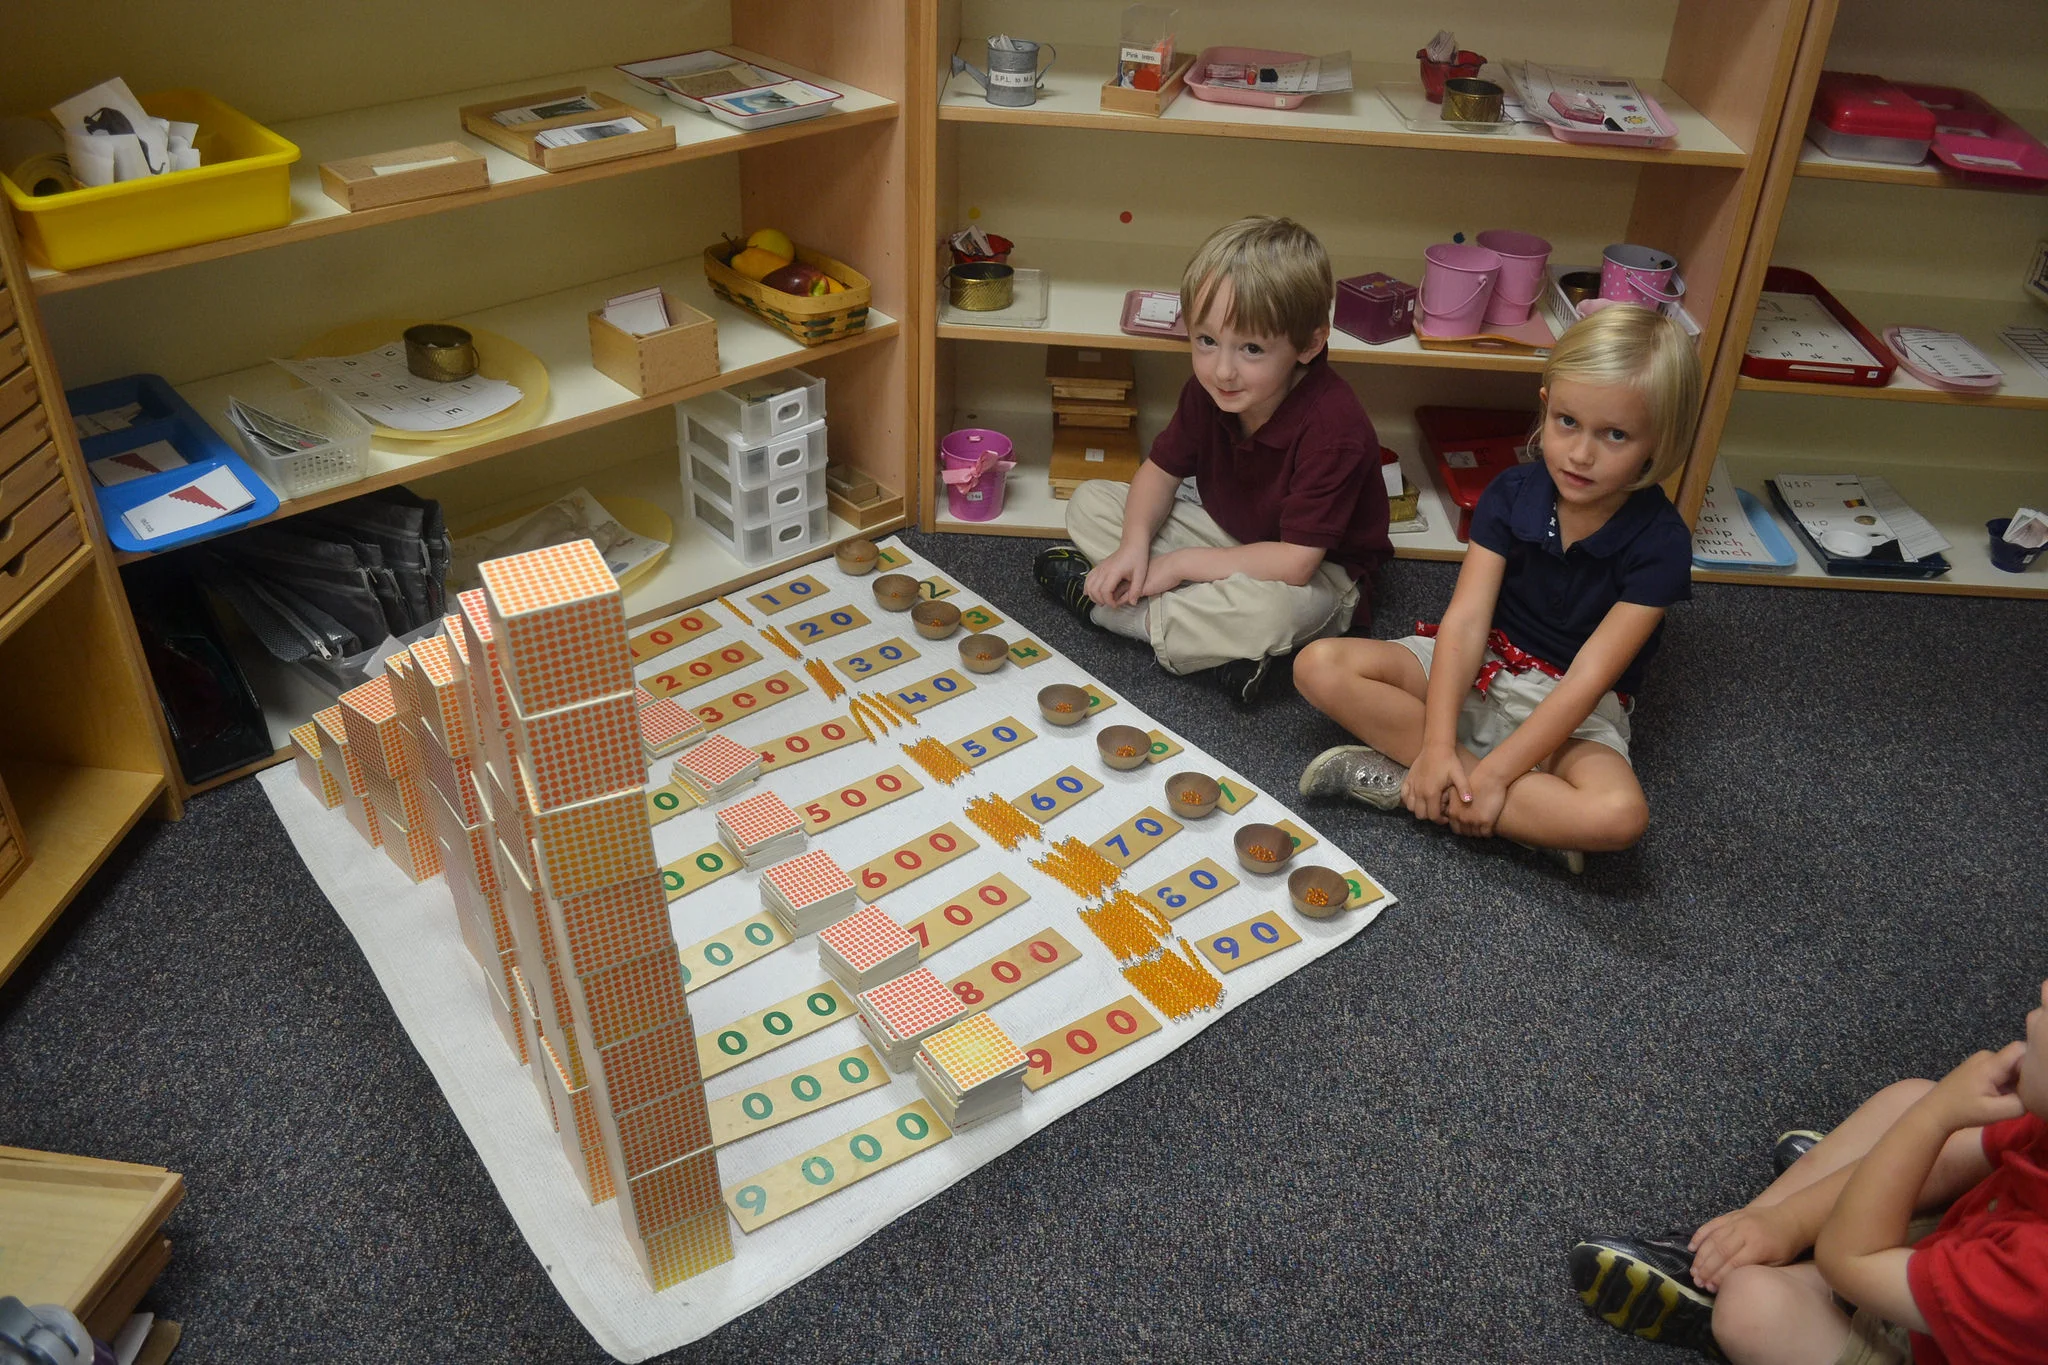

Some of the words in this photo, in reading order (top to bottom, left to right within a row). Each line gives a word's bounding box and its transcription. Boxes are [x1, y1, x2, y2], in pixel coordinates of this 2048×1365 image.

[1694, 526, 1732, 538] chip
[1697, 538, 1744, 547] much
[1699, 545, 1752, 557] lunch
[761, 581, 812, 605] 10
[919, 580, 950, 599] 2
[799, 612, 853, 637] 20
[966, 610, 989, 625] 3
[848, 645, 903, 672] 30
[1010, 645, 1038, 659] 4
[655, 648, 745, 691] 200
[699, 679, 789, 723] 300
[898, 677, 957, 704] 40
[961, 726, 1018, 758] 50
[805, 774, 902, 823] 500
[1030, 776, 1083, 811] 60
[1104, 818, 1163, 857] 70
[861, 832, 957, 889] 600
[1157, 869, 1218, 908] 80
[1212, 922, 1280, 960] 90
[952, 941, 1059, 1005] 800
[735, 1112, 929, 1217] 9000
